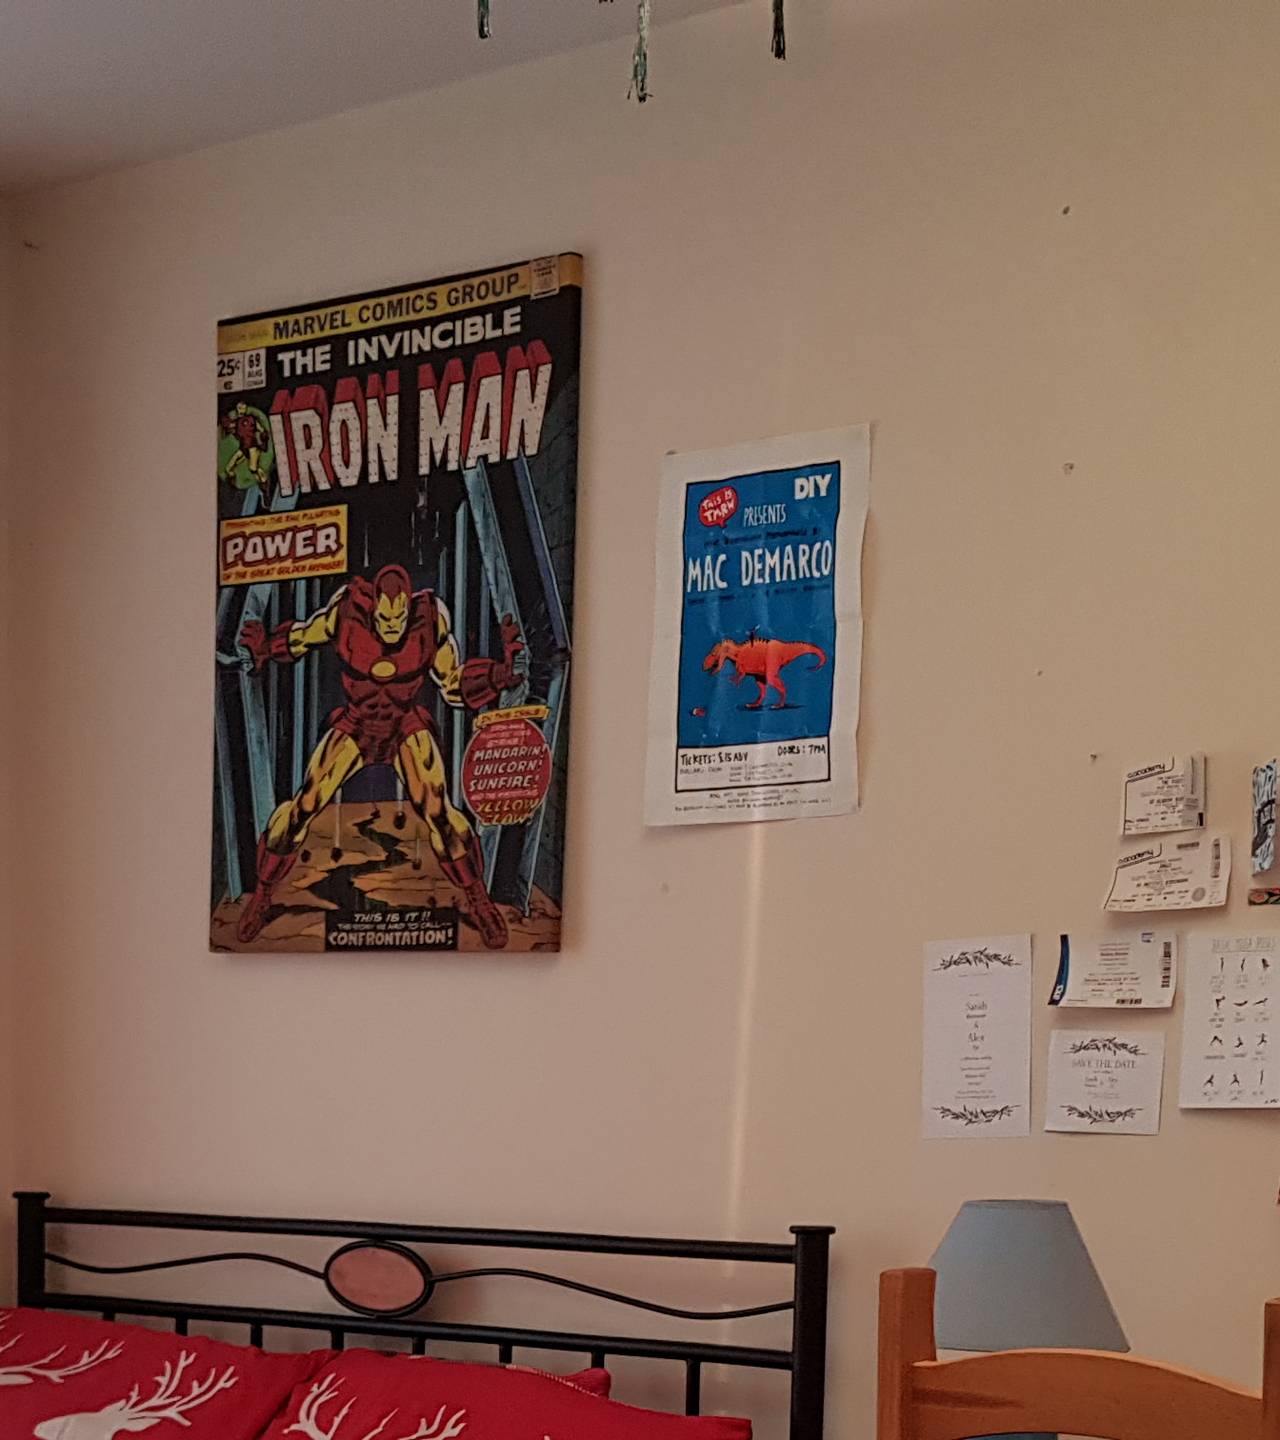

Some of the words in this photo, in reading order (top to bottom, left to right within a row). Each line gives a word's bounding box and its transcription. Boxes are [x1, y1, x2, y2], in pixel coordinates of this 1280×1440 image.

[273, 311, 351, 340] MARVEL
[358, 292, 438, 328] COMICS
[447, 273, 519, 306] GROUP
[278, 345, 331, 378] THE
[348, 306, 521, 366] INVINCIBLE
[248, 353, 260, 368] 69
[269, 385, 399, 497] IRON
[419, 360, 552, 476] MAN
[794, 474, 832, 500] DIY
[744, 504, 786, 527] PRESENTS
[225, 525, 339, 564] POWER
[687, 554, 728, 592] MAC
[741, 540, 832, 587] DEMARCO
[473, 745, 545, 762] MANDARIN!
[474, 760, 542, 776] UNICORN!
[468, 775, 539, 792] SUNFIRE!
[354, 913, 382, 922] THIS
[385, 913, 400, 922] IS
[328, 927, 453, 946] CONFRONTATION!
[1096, 1060, 1112, 1069] THE
[1114, 1059, 1136, 1069] DATE
